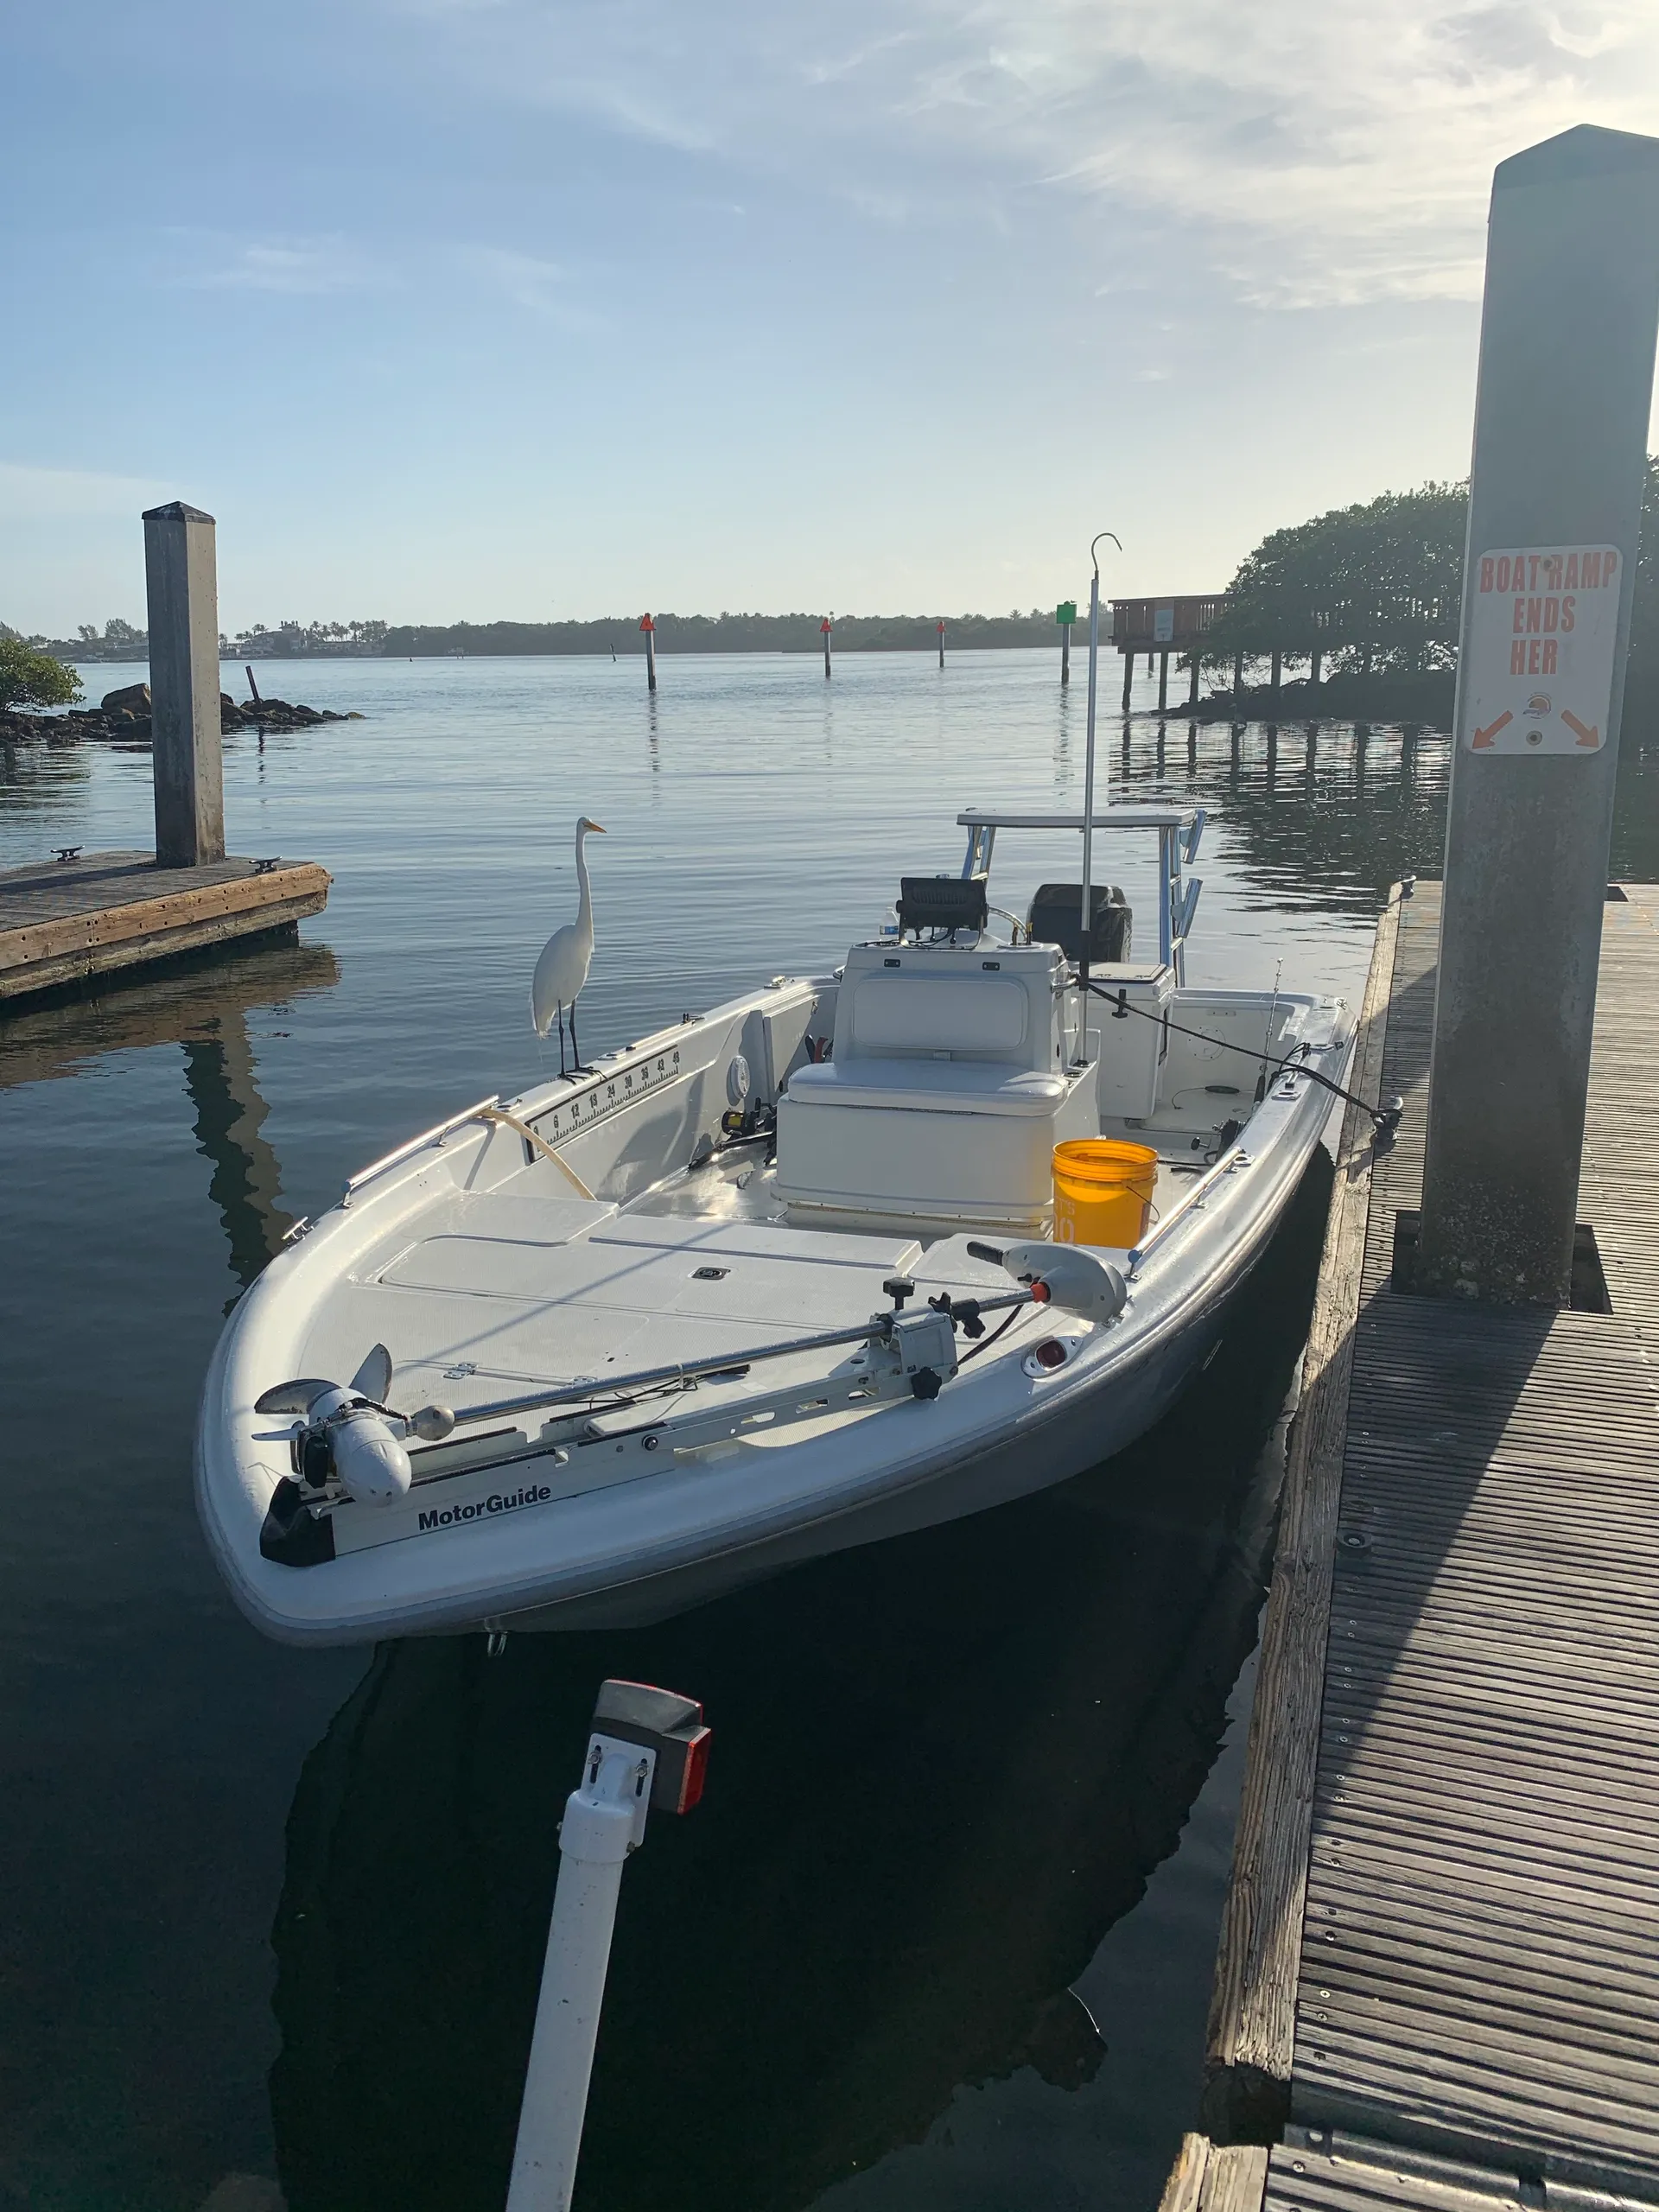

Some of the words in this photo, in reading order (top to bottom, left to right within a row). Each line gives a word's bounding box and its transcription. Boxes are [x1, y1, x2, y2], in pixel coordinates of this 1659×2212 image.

[1479, 555, 1541, 594] BOAT
[1548, 551, 1618, 591] RAMP
[1512, 595, 1576, 634] ENDS
[1510, 639, 1559, 676] HER
[553, 1114, 559, 1128] 6
[571, 1103, 580, 1120] 12
[607, 1083, 615, 1099] 24
[418, 1485, 551, 1531] MotorGuide
